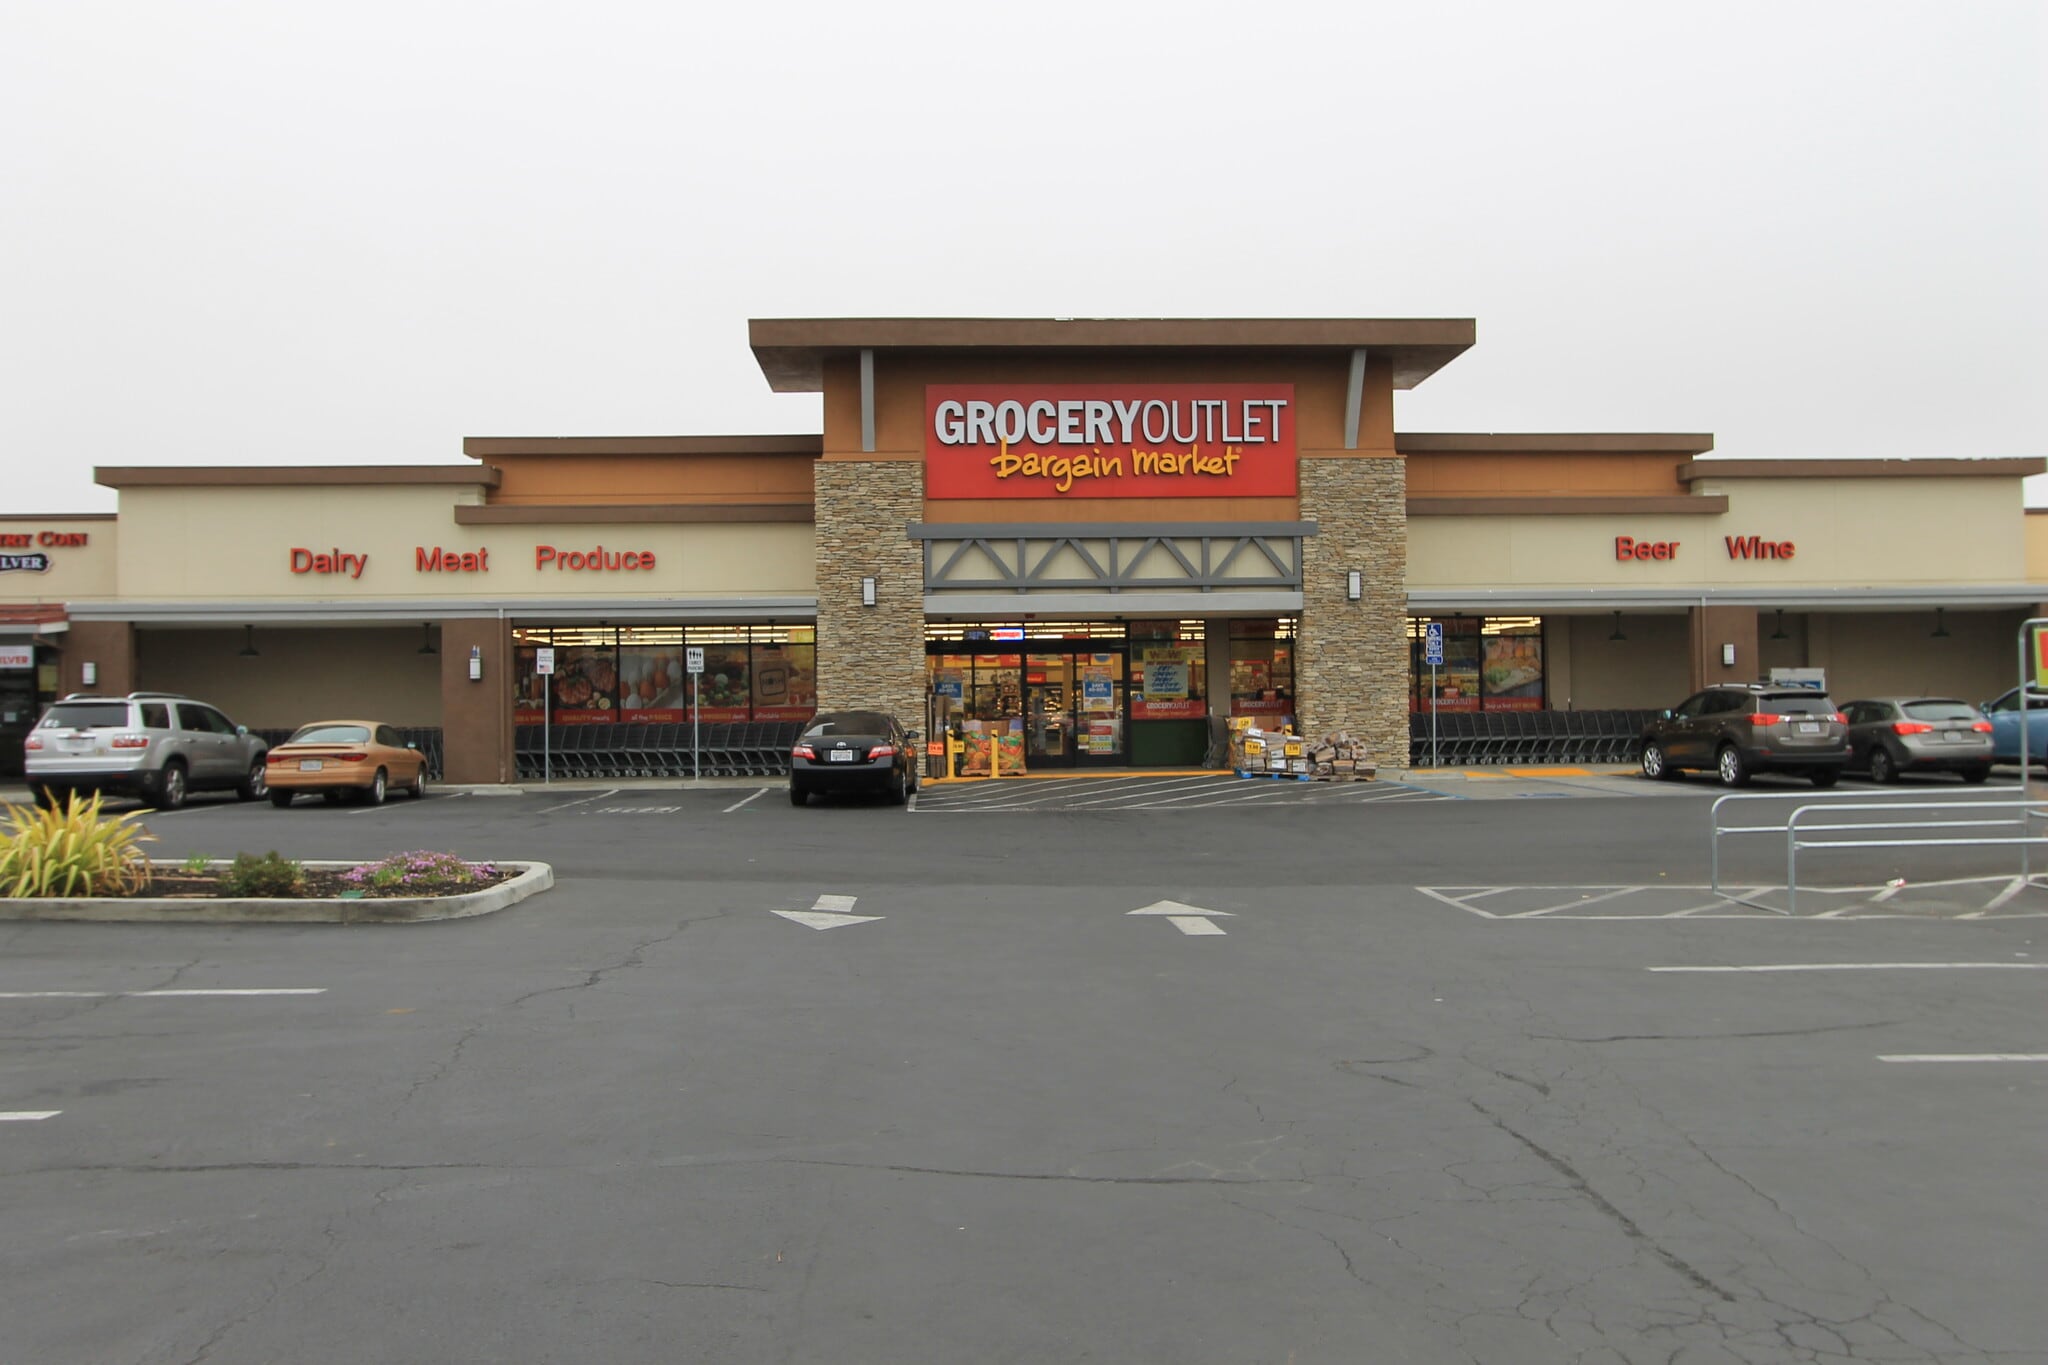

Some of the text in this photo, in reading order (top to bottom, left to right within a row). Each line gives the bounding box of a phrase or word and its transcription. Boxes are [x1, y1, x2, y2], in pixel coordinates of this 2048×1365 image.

[935, 400, 1288, 444] GROCERYOUTLET
[990, 436, 1124, 492] bargain
[37, 531, 88, 548] COIN
[1615, 535, 1681, 561] Beer
[1725, 535, 1796, 560] Wine
[290, 547, 368, 579] Dairy
[415, 546, 488, 573] Meat
[535, 545, 656, 571] Produce
